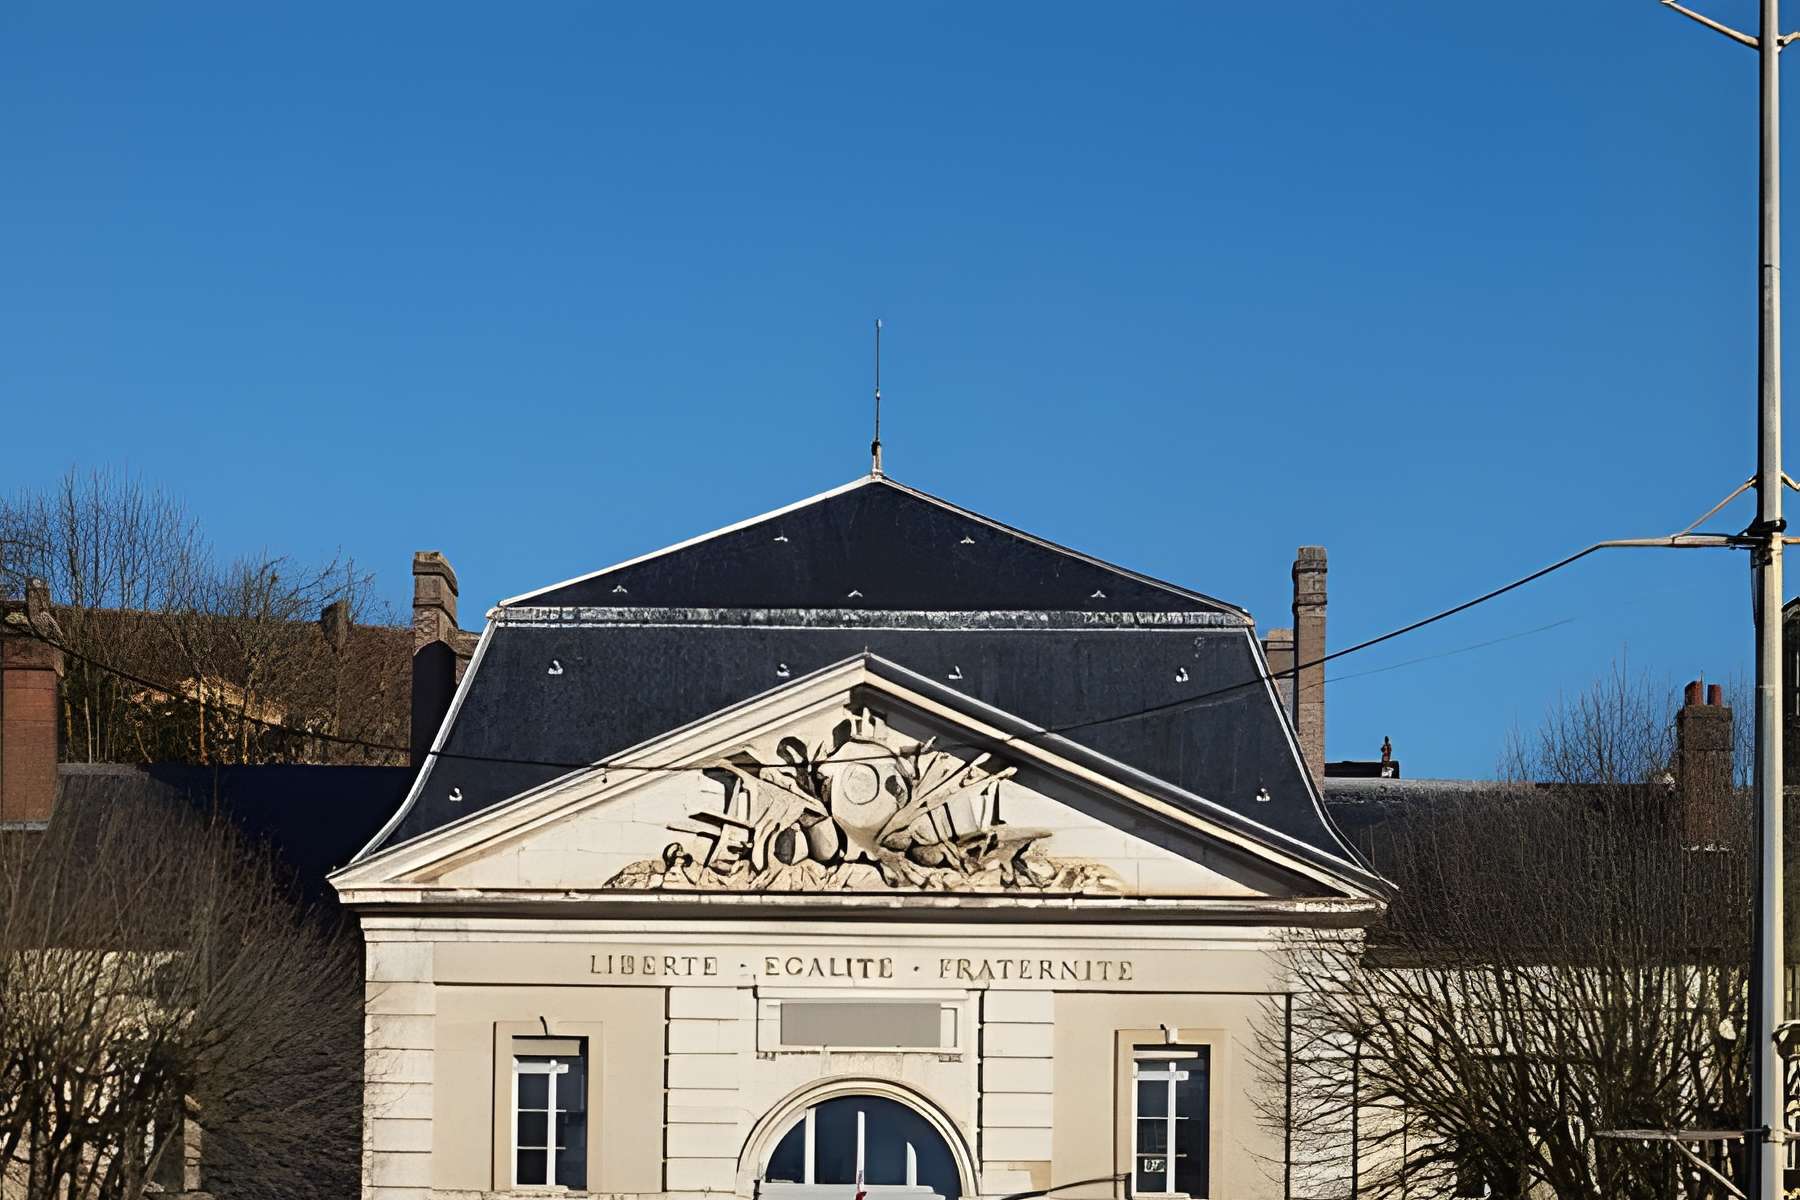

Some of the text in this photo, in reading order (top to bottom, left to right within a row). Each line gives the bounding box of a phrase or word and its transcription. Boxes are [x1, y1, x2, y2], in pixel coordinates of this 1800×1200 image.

[590, 954, 1133, 981] LIBERTE EGALITE FRATERNITE
